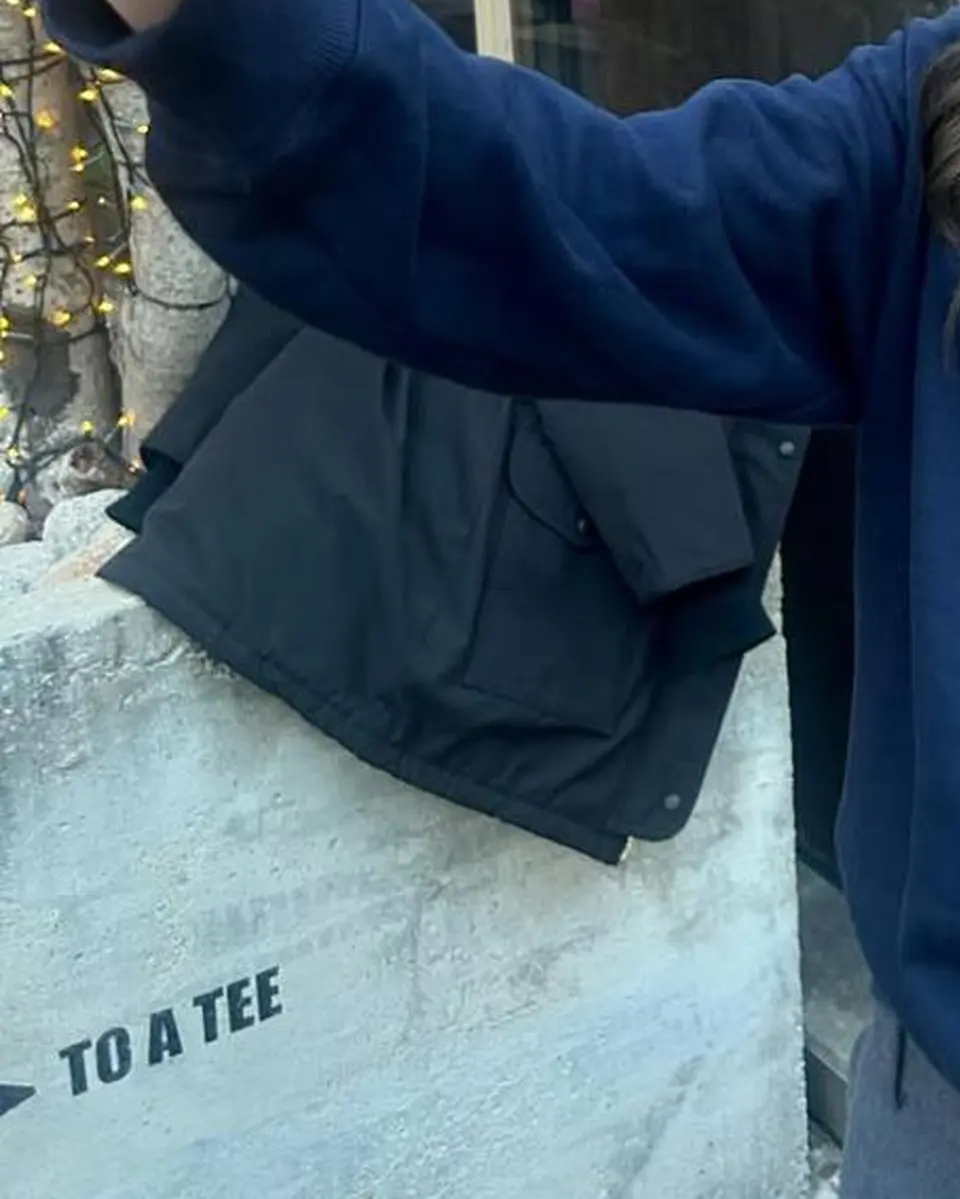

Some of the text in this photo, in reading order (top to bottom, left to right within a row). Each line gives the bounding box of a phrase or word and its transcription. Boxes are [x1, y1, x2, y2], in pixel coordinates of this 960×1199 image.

[58, 966, 282, 1096] TO A TEE
